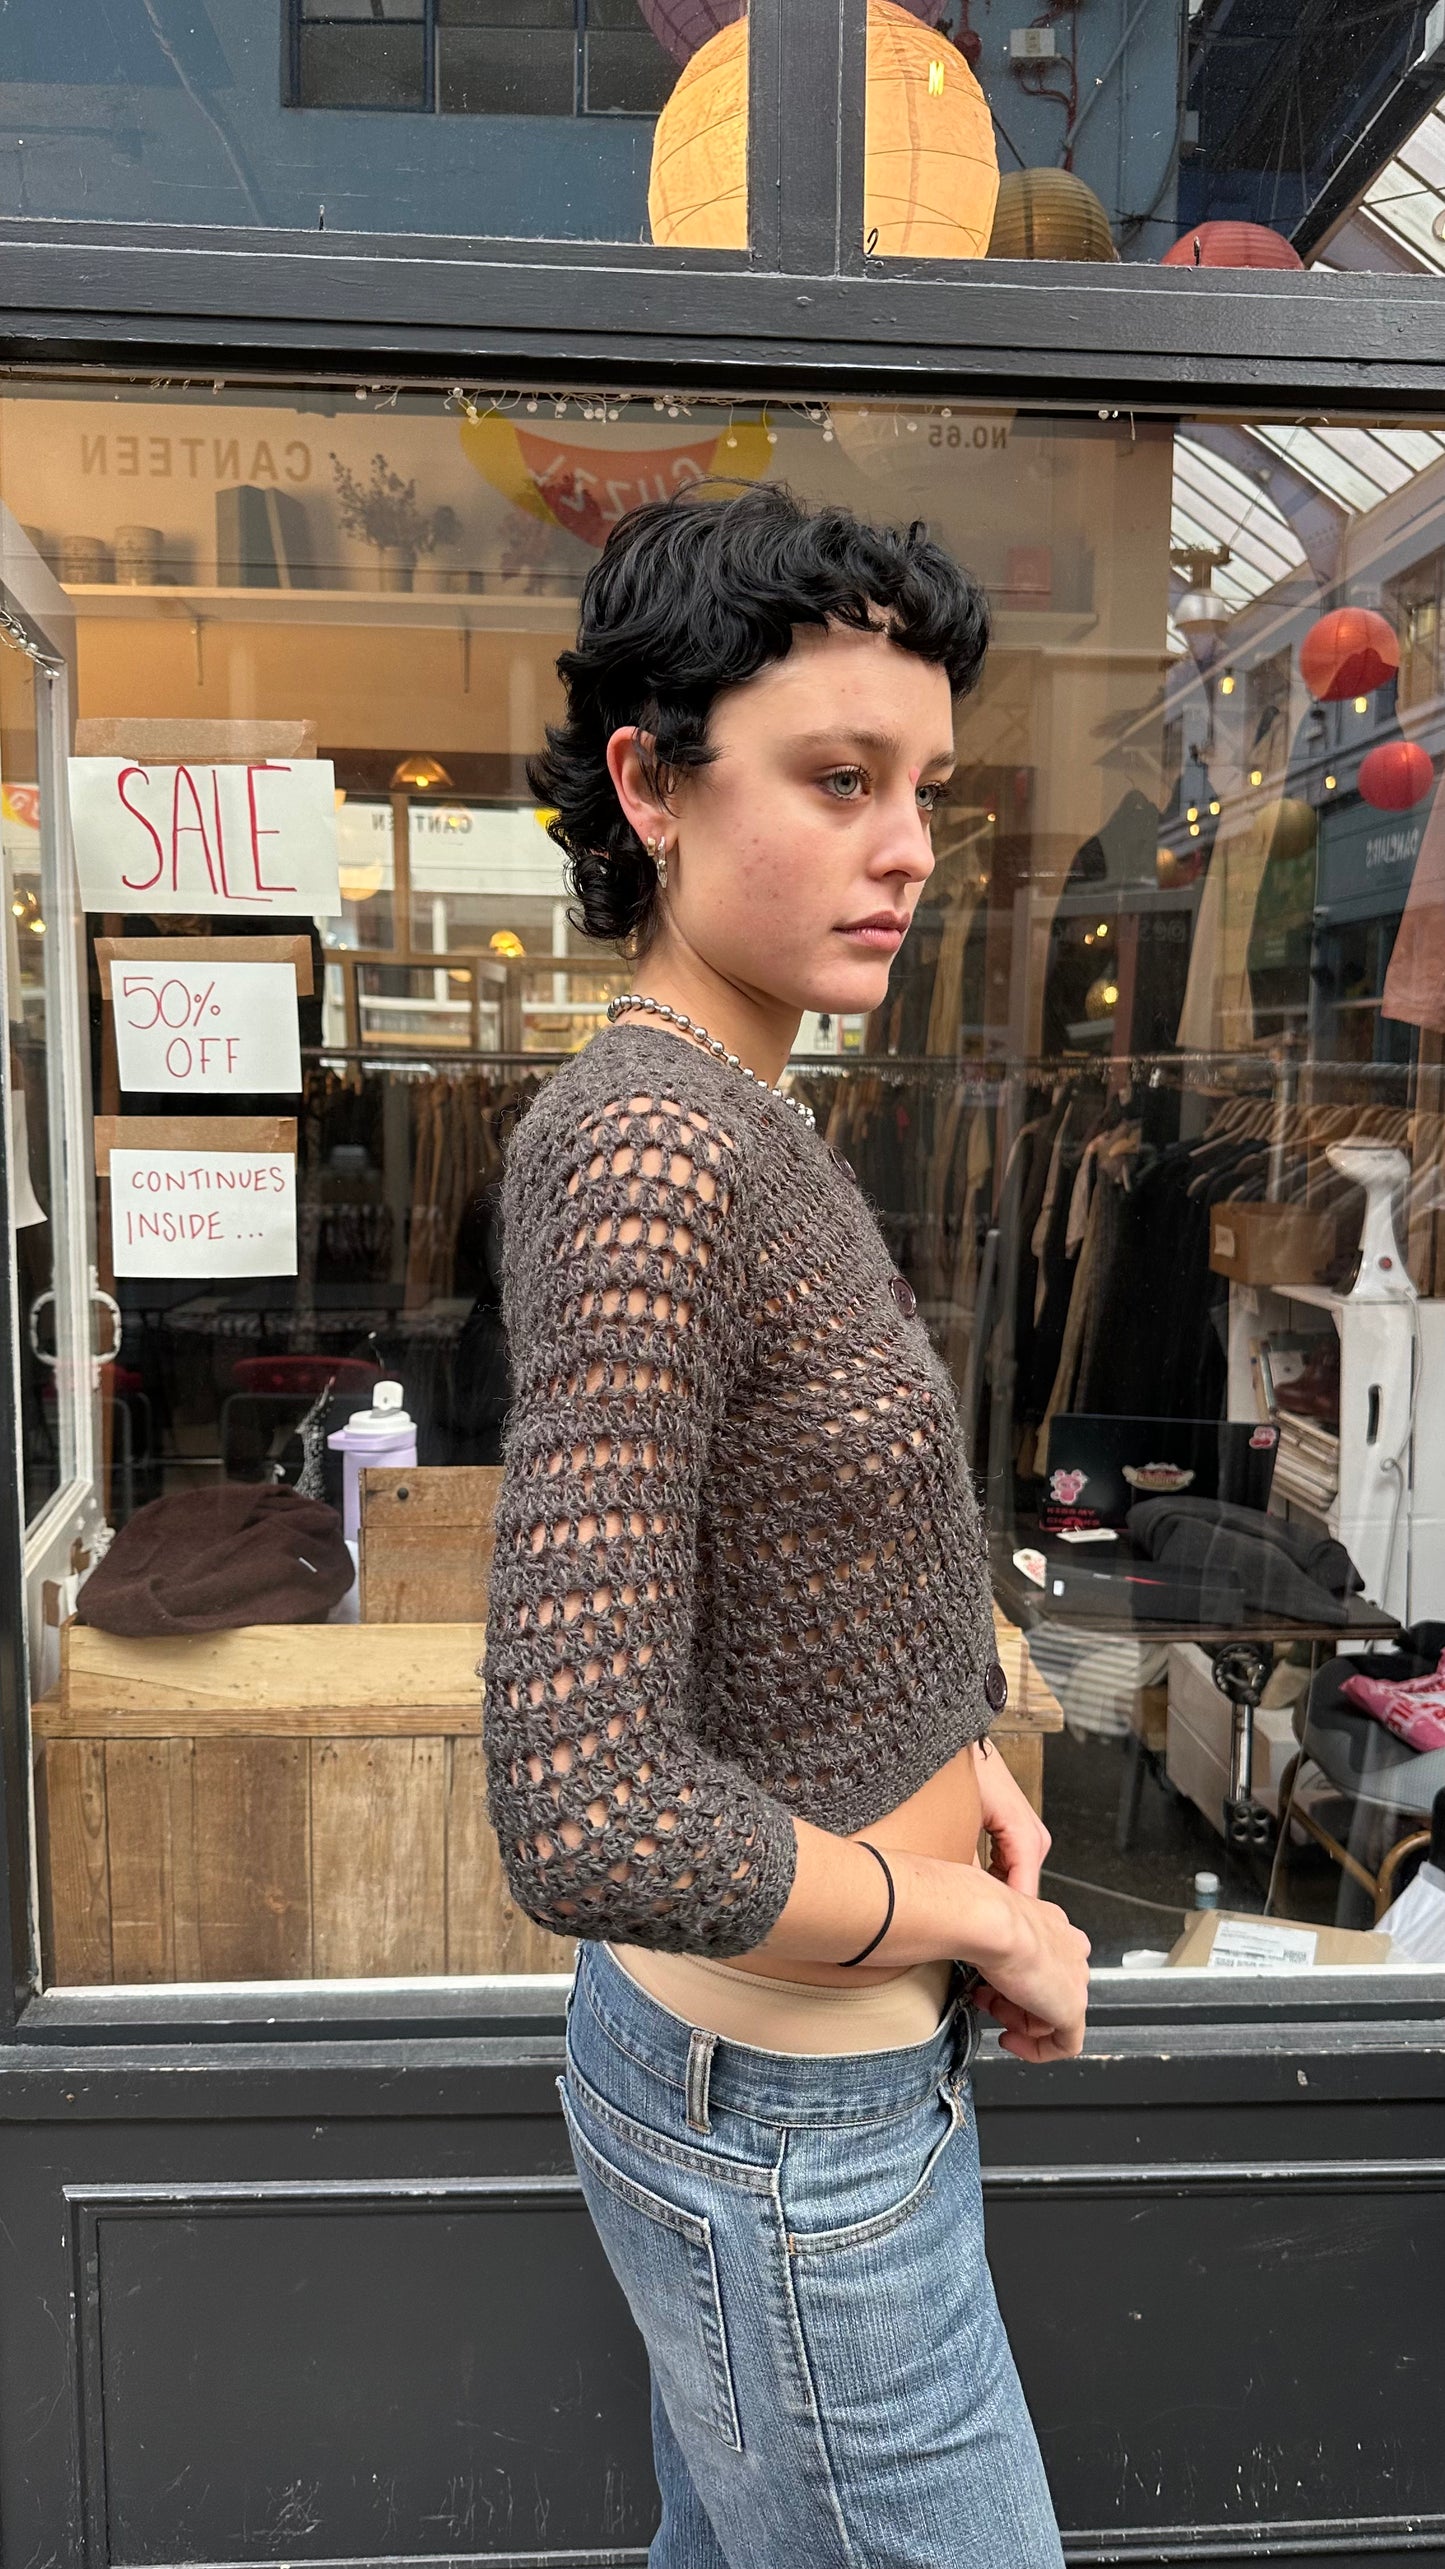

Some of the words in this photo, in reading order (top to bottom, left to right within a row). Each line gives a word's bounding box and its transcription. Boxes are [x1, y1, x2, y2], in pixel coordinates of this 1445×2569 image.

[117, 765, 298, 902] SALE
[123, 976, 221, 1029] 50%
[166, 1037, 241, 1078] OFF
[131, 1166, 286, 1193] CONTINUES
